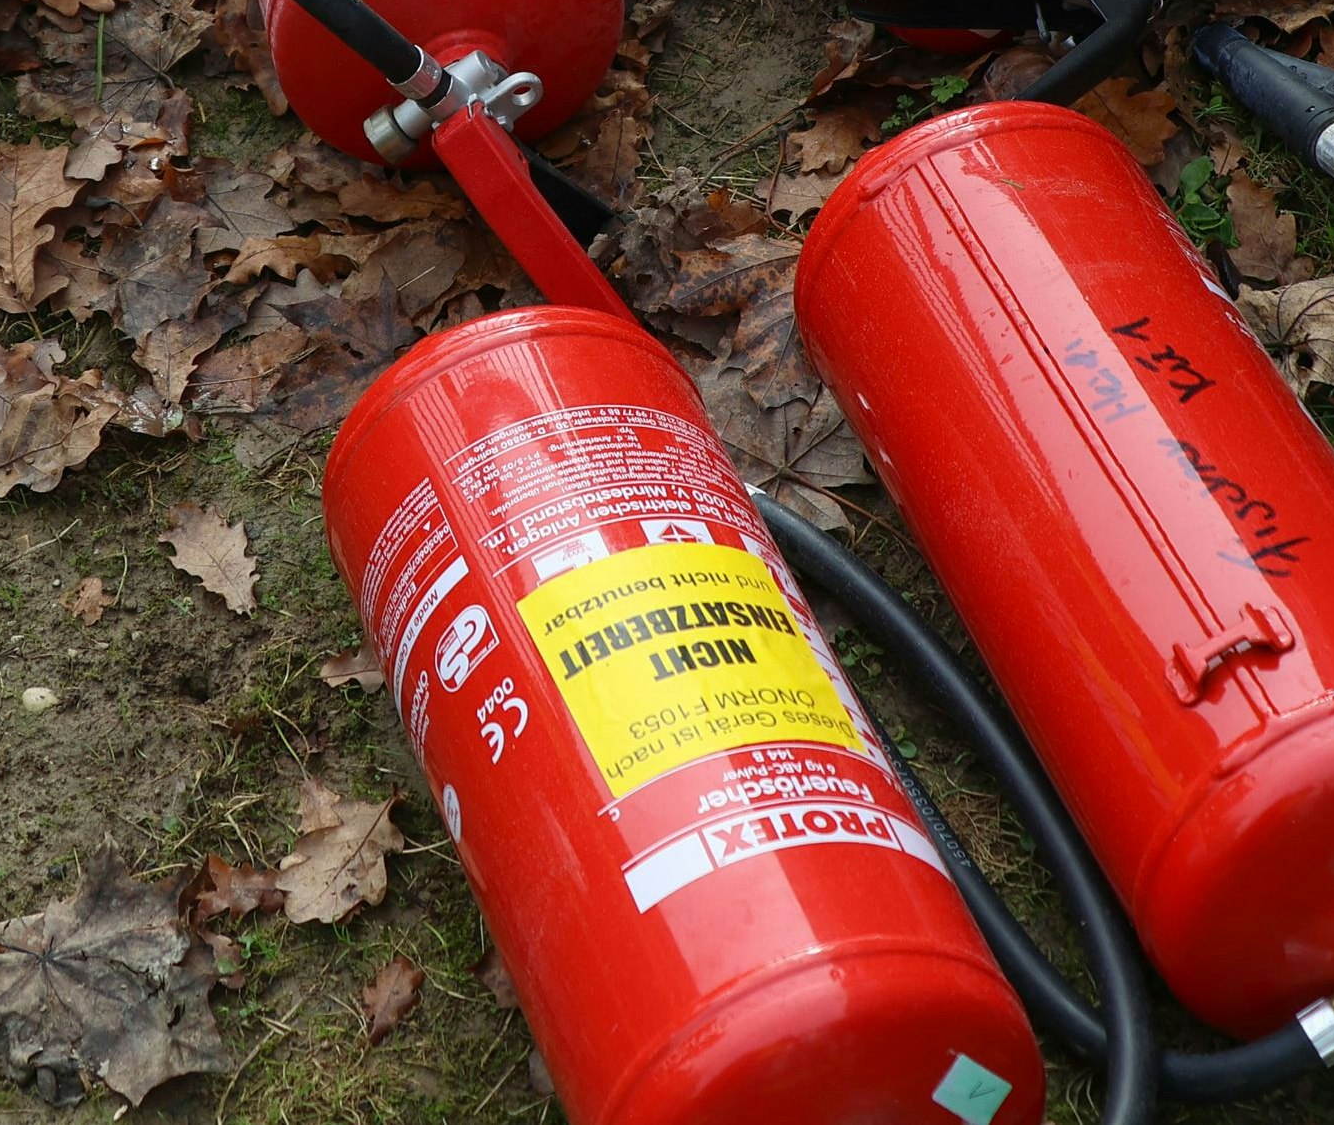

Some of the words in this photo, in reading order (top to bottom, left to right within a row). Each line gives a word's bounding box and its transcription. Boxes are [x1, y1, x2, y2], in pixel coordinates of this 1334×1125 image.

[456, 445, 499, 474] Ratingen
[520, 484, 667, 534] Mindestabstand
[585, 499, 693, 524] elektrischen
[690, 488, 727, 512] 1000
[695, 502, 719, 520] bei
[481, 529, 505, 551] m.
[500, 512, 581, 558] Anlagen.
[506, 520, 519, 539] 1
[669, 570, 730, 590] nicht
[735, 575, 771, 592] und
[411, 588, 440, 624] Made
[540, 575, 664, 636] benutzbar
[403, 624, 417, 643] in
[556, 606, 796, 679] EINSATZBEREIT
[648, 637, 757, 681] NICHT
[473, 674, 517, 724] 0044
[714, 689, 814, 709] ÖNORM
[627, 696, 708, 740] F1053
[705, 712, 777, 737] Gerät
[782, 711, 855, 740] Dieses
[476, 698, 539, 765] CE
[671, 725, 701, 746] ist
[605, 739, 665, 780] nach
[766, 747, 794, 761] 144
[804, 758, 824, 773] kg
[721, 759, 802, 783] ABC-Pulver
[695, 774, 875, 815] Feuerlöscher
[607, 806, 621, 821] C
[710, 812, 892, 857] PROTEX
